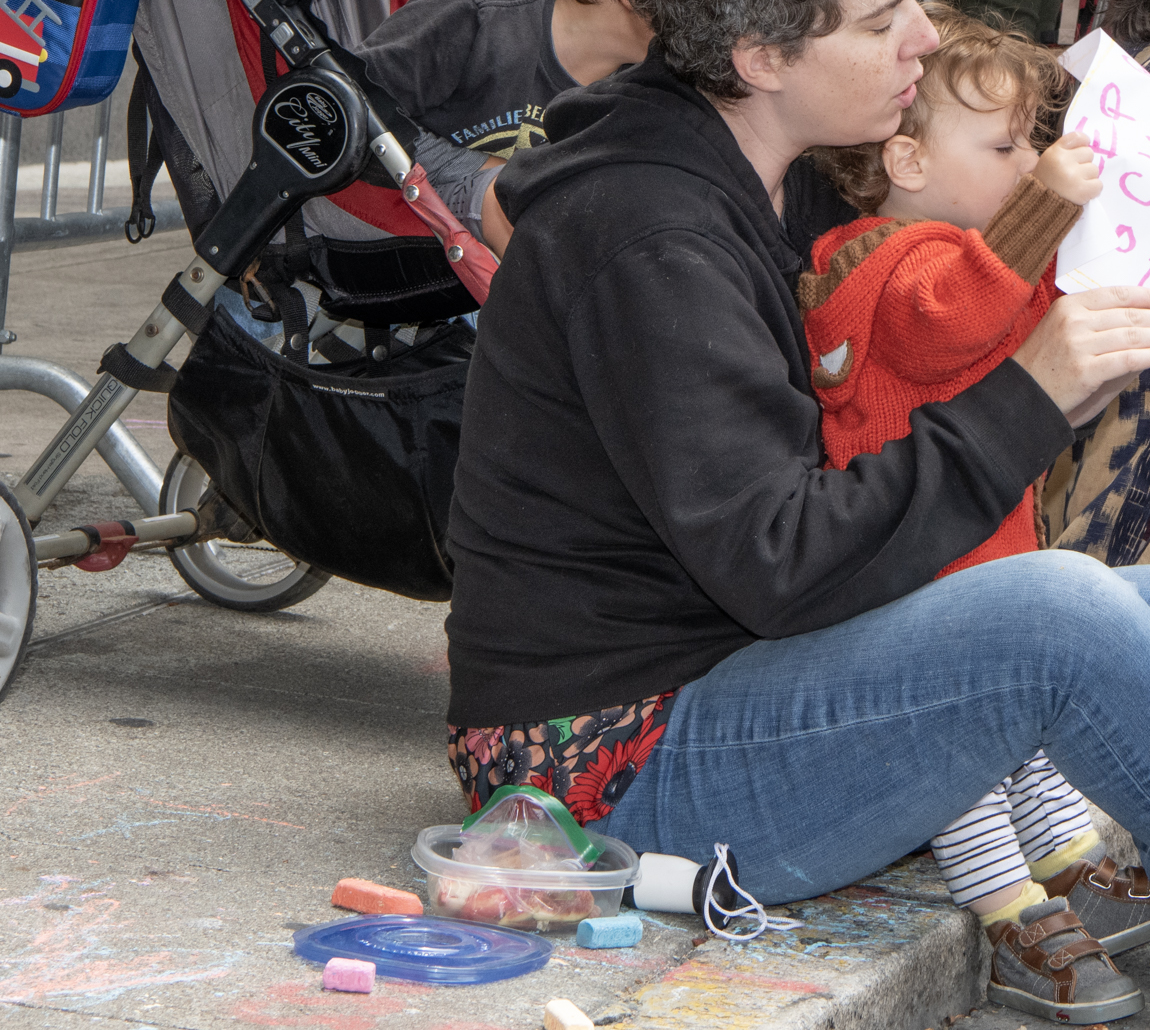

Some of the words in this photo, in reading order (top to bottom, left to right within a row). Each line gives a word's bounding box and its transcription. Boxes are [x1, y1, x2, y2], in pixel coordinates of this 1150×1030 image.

[274, 96, 322, 149] City
[85, 378, 118, 420] QUICK
[60, 417, 88, 453] FOLD
